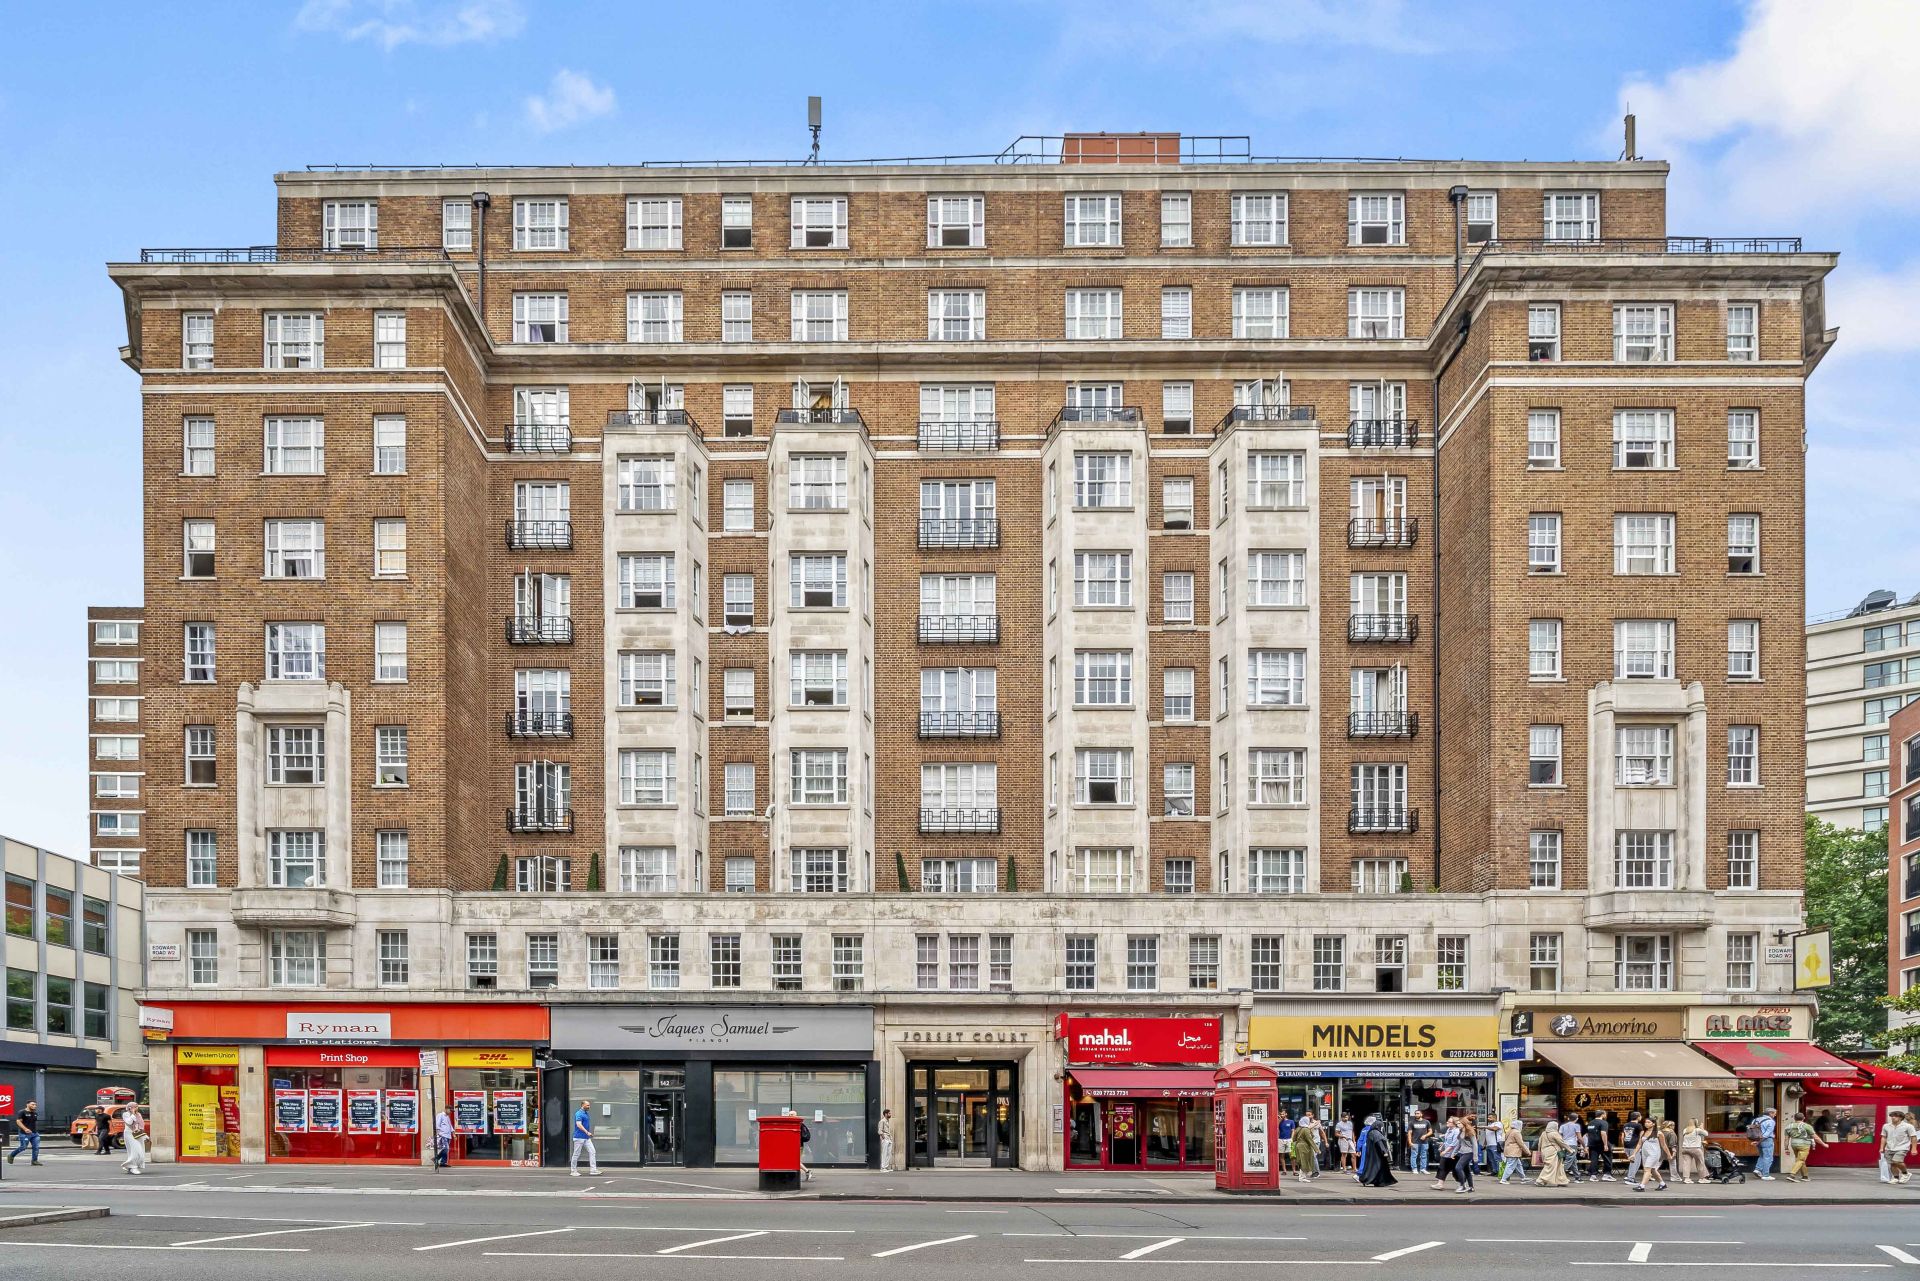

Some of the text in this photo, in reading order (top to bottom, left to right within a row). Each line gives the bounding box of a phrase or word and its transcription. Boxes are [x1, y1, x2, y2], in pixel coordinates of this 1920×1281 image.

[298, 1022, 380, 1034] Ryman
[649, 1014, 769, 1038] Jaques Samuel
[1579, 1016, 1658, 1035] Amorino
[1706, 1014, 1733, 1030] AL
[903, 1032, 1028, 1042] FORSET COURT
[1079, 1028, 1132, 1045] mahal.
[1177, 1031, 1202, 1047] محل
[1312, 1024, 1436, 1047] MINDELS
[320, 1053, 369, 1063] Print Shop
[1312, 1050, 1434, 1058] LUGGAGE AND TRAVEL GOODS
